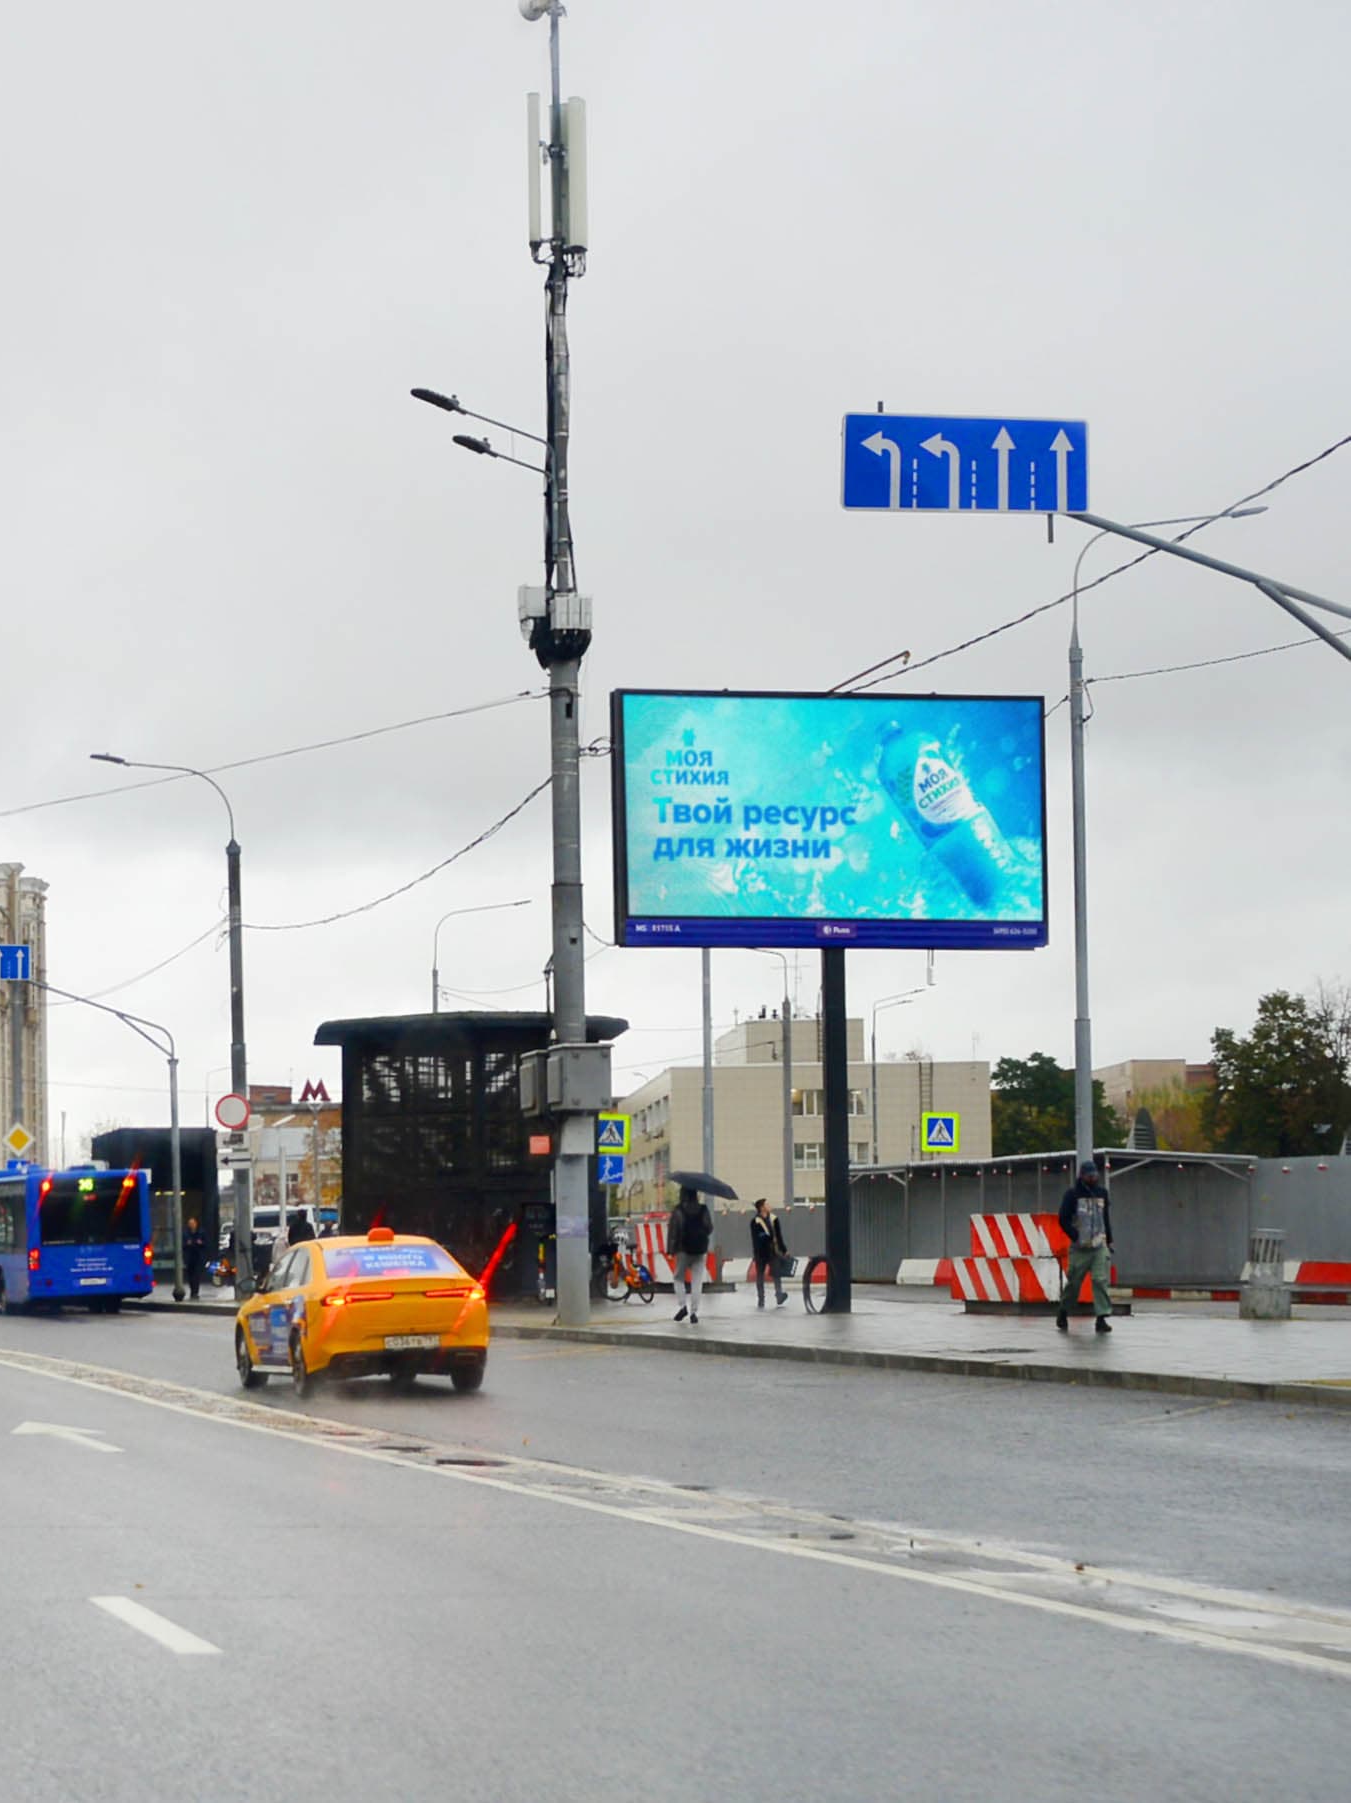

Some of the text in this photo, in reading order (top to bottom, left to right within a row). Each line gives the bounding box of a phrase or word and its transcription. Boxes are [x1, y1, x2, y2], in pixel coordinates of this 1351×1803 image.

[665, 750, 714, 767] МОЯ
[650, 768, 730, 786] СТИХИЯ
[652, 796, 858, 832] Твой ресурс
[653, 836, 831, 861] для жизни
